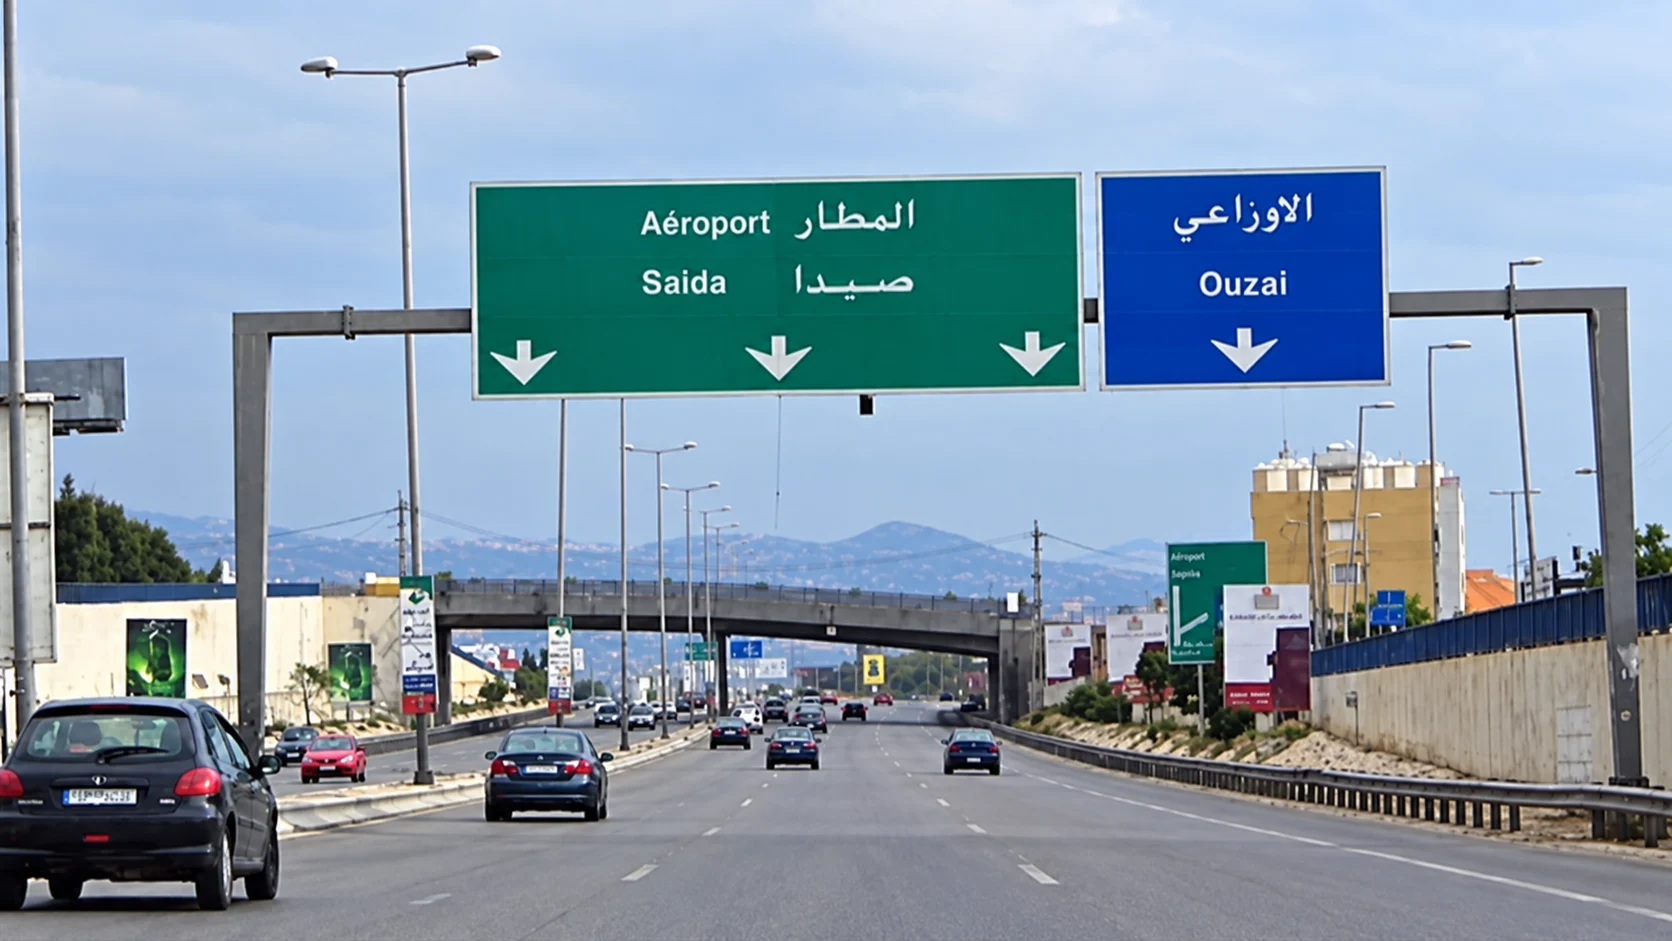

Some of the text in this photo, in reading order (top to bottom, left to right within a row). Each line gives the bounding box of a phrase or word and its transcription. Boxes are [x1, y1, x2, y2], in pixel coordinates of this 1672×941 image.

[641, 209, 771, 239] Aéroport
[794, 199, 915, 240] المطار
[1173, 193, 1313, 243] الاوزاعي
[642, 269, 726, 295] Saida
[794, 264, 914, 302] صيدا
[1199, 270, 1287, 297] Ouzai
